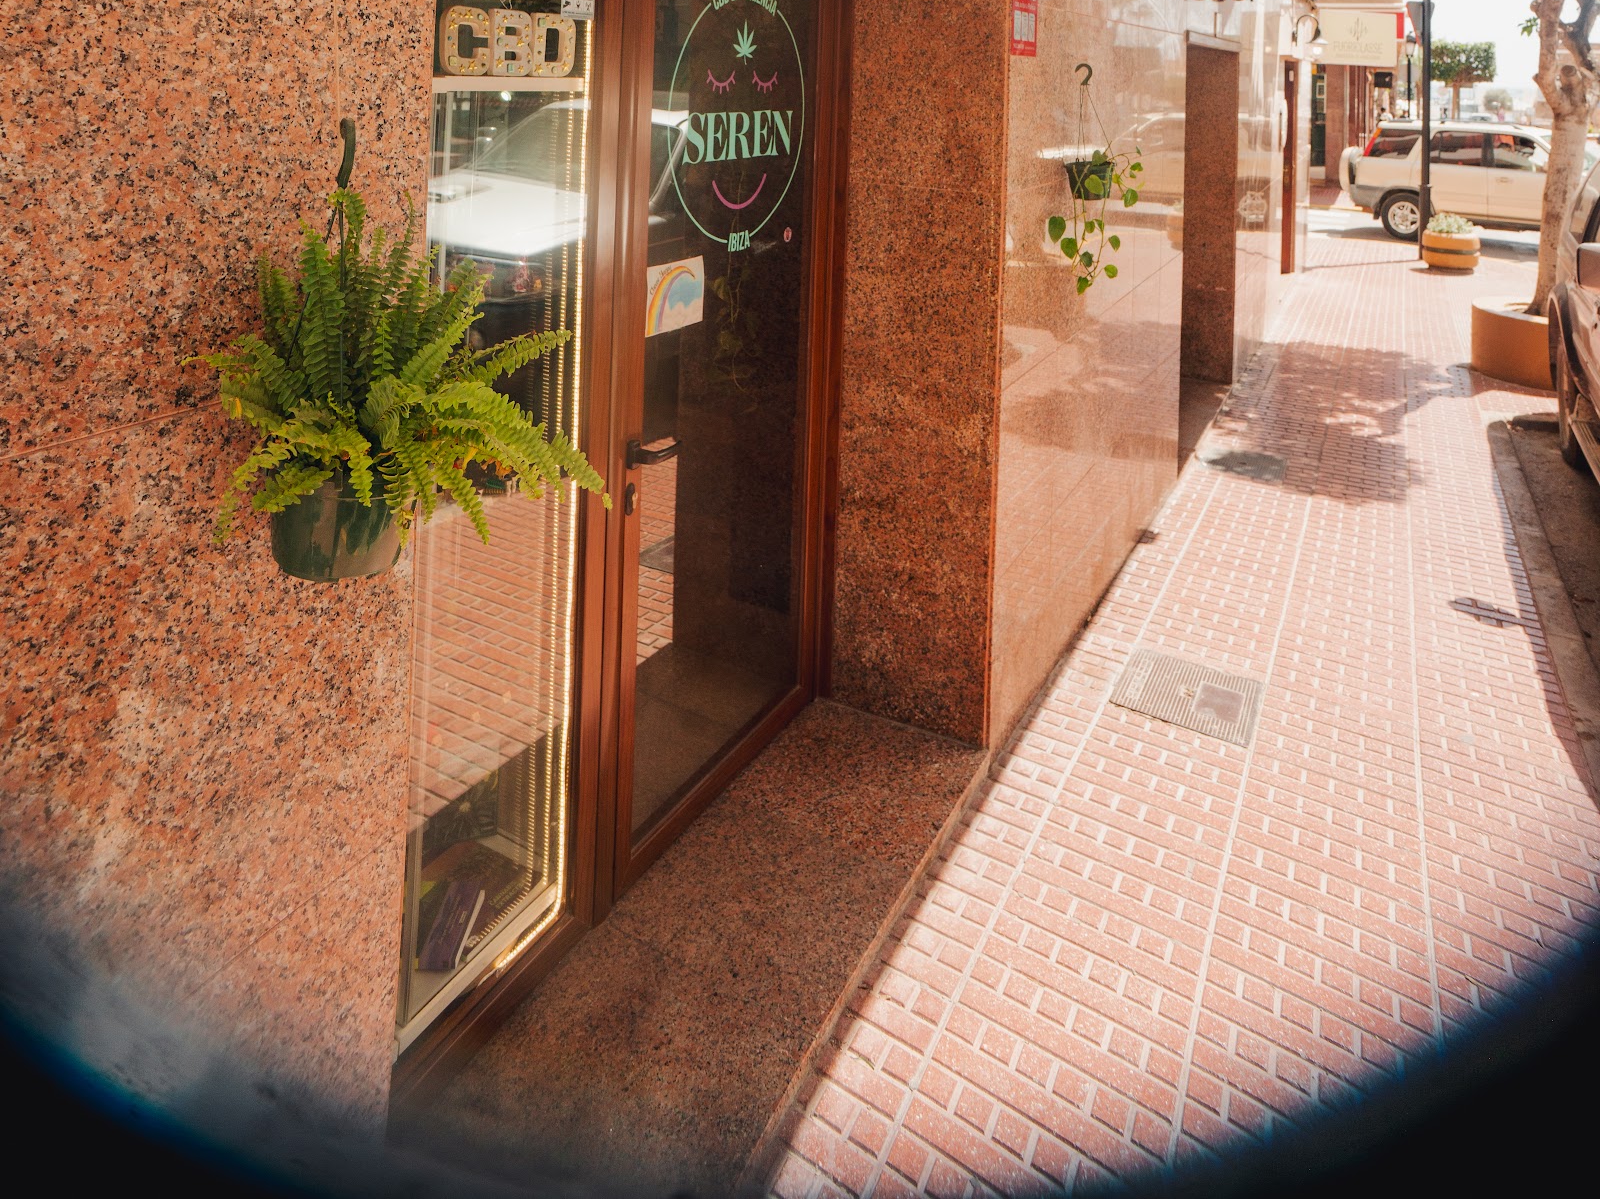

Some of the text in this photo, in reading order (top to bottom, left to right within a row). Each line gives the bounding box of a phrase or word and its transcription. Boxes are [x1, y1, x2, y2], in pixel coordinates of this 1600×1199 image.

[439, 4, 577, 78] CBD
[681, 109, 794, 166] SEREN
[727, 229, 751, 253] IBIZA
